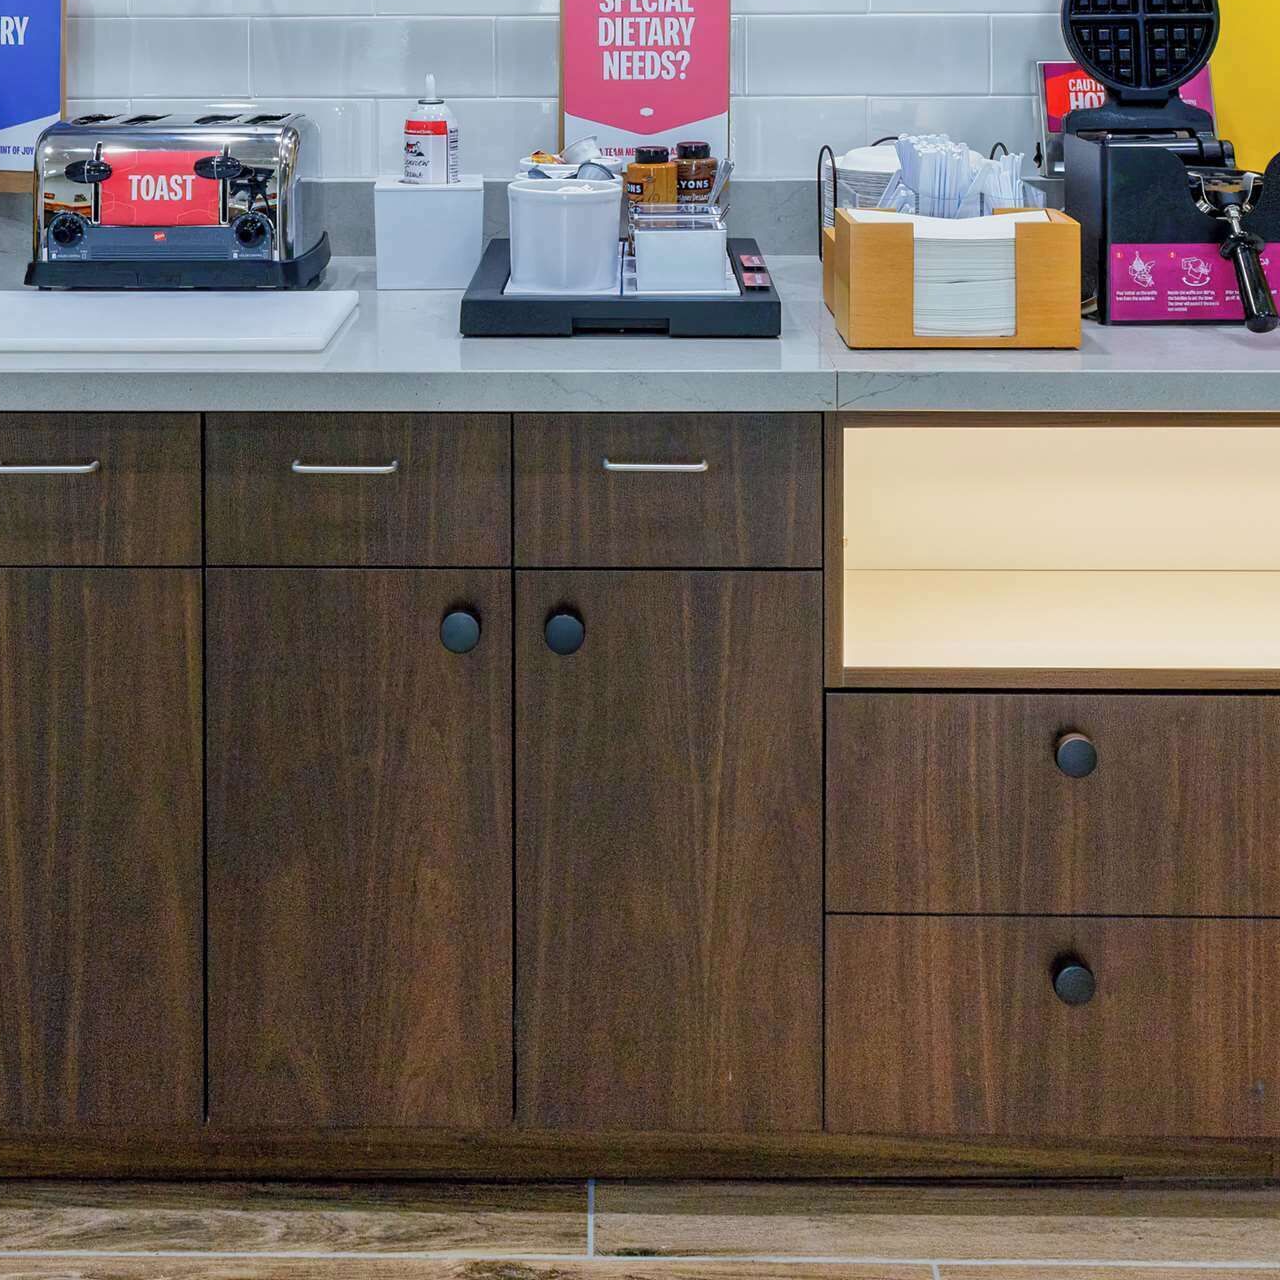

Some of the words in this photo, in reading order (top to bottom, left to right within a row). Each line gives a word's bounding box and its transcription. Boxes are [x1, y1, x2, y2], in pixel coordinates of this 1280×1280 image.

[598, 16, 696, 48] DIETARY
[603, 49, 691, 81] NEEDS?
[12, 146, 21, 155] OF
[21, 146, 35, 156] JOY
[128, 174, 196, 202] TOAST
